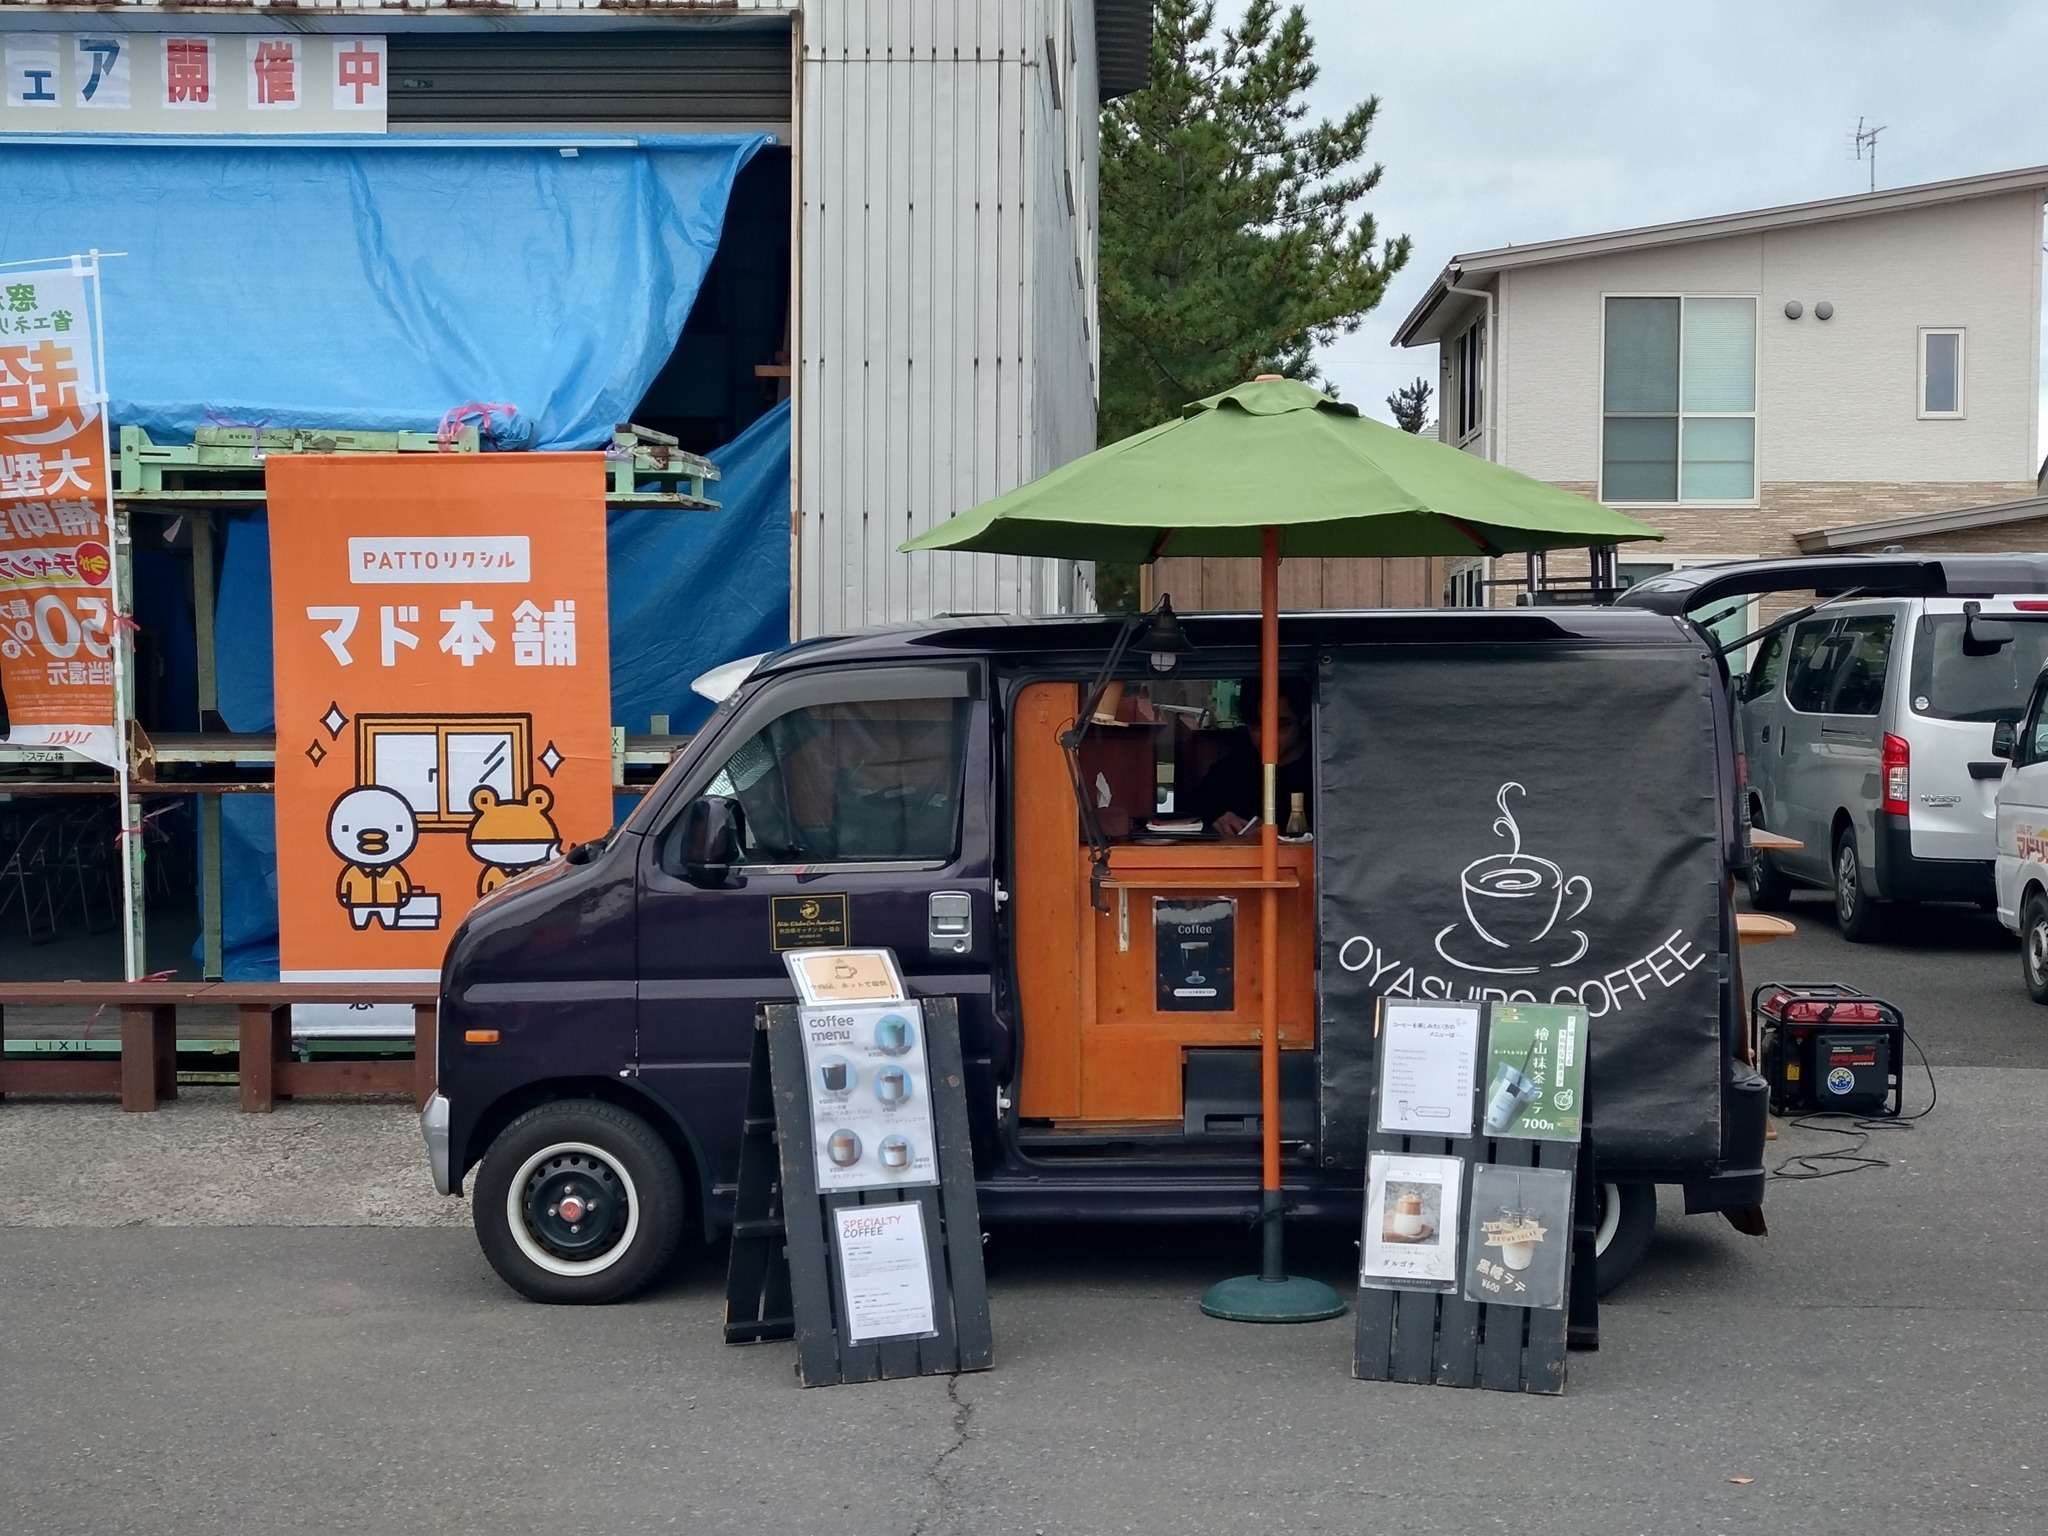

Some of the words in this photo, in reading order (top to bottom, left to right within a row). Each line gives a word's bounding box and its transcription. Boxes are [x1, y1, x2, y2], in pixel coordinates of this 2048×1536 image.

[363, 551, 515, 570] PATTOリクシル
[305, 599, 577, 667] マド本舗
[1920, 794, 1962, 803] NV350
[1177, 924, 1213, 934] Coffee
[809, 1015, 855, 1028] coffee
[811, 1029, 850, 1042] menu
[35, 1041, 92, 1050] LIXIL
[1522, 1118, 1554, 1130] 700円
[843, 1215, 902, 1230] SPECIALTY
[843, 1227, 884, 1239] COFFEE
[1476, 1258, 1526, 1292] 黒糖ラテ
[1481, 1278, 1501, 1293] ¥600
